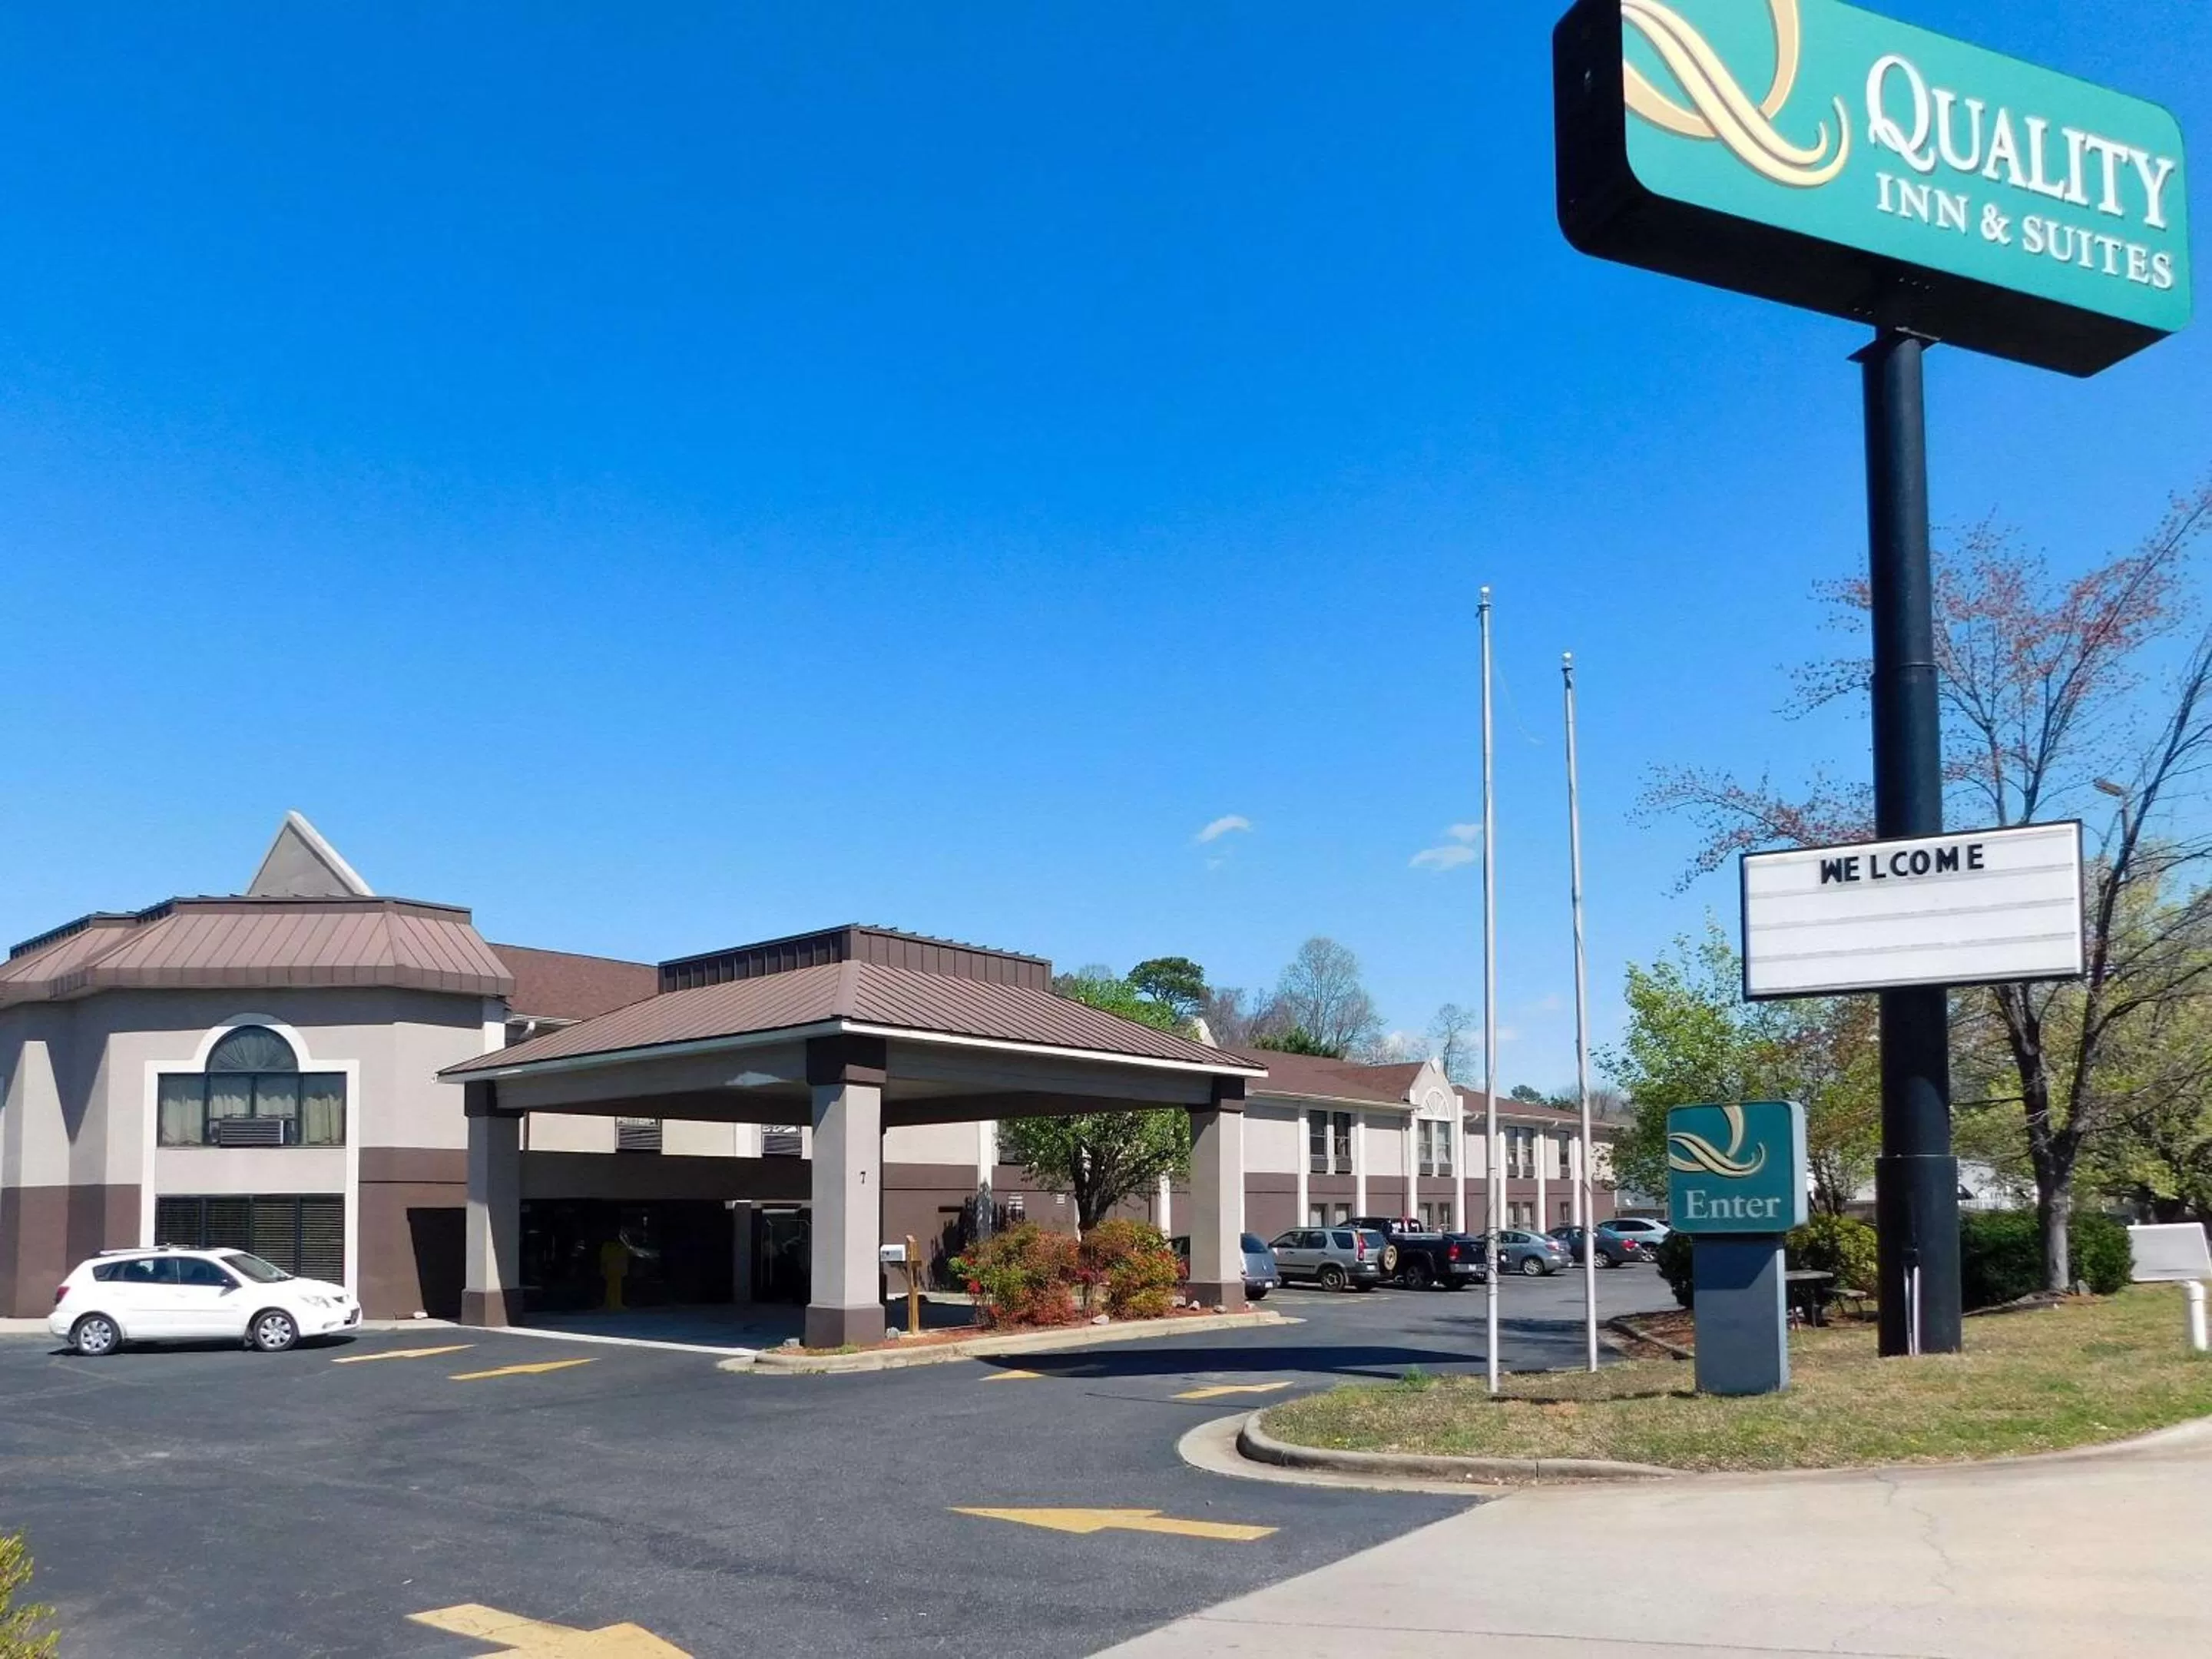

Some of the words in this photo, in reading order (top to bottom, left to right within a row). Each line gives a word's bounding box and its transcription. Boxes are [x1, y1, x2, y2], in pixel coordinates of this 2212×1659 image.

[1866, 54, 2174, 228] QUALITY
[1876, 172, 1969, 233] INN
[1980, 203, 2012, 245] &
[2022, 215, 2174, 290] SUITES
[1820, 844, 1985, 884] WELCOME
[1684, 1190, 1781, 1219] Enter
